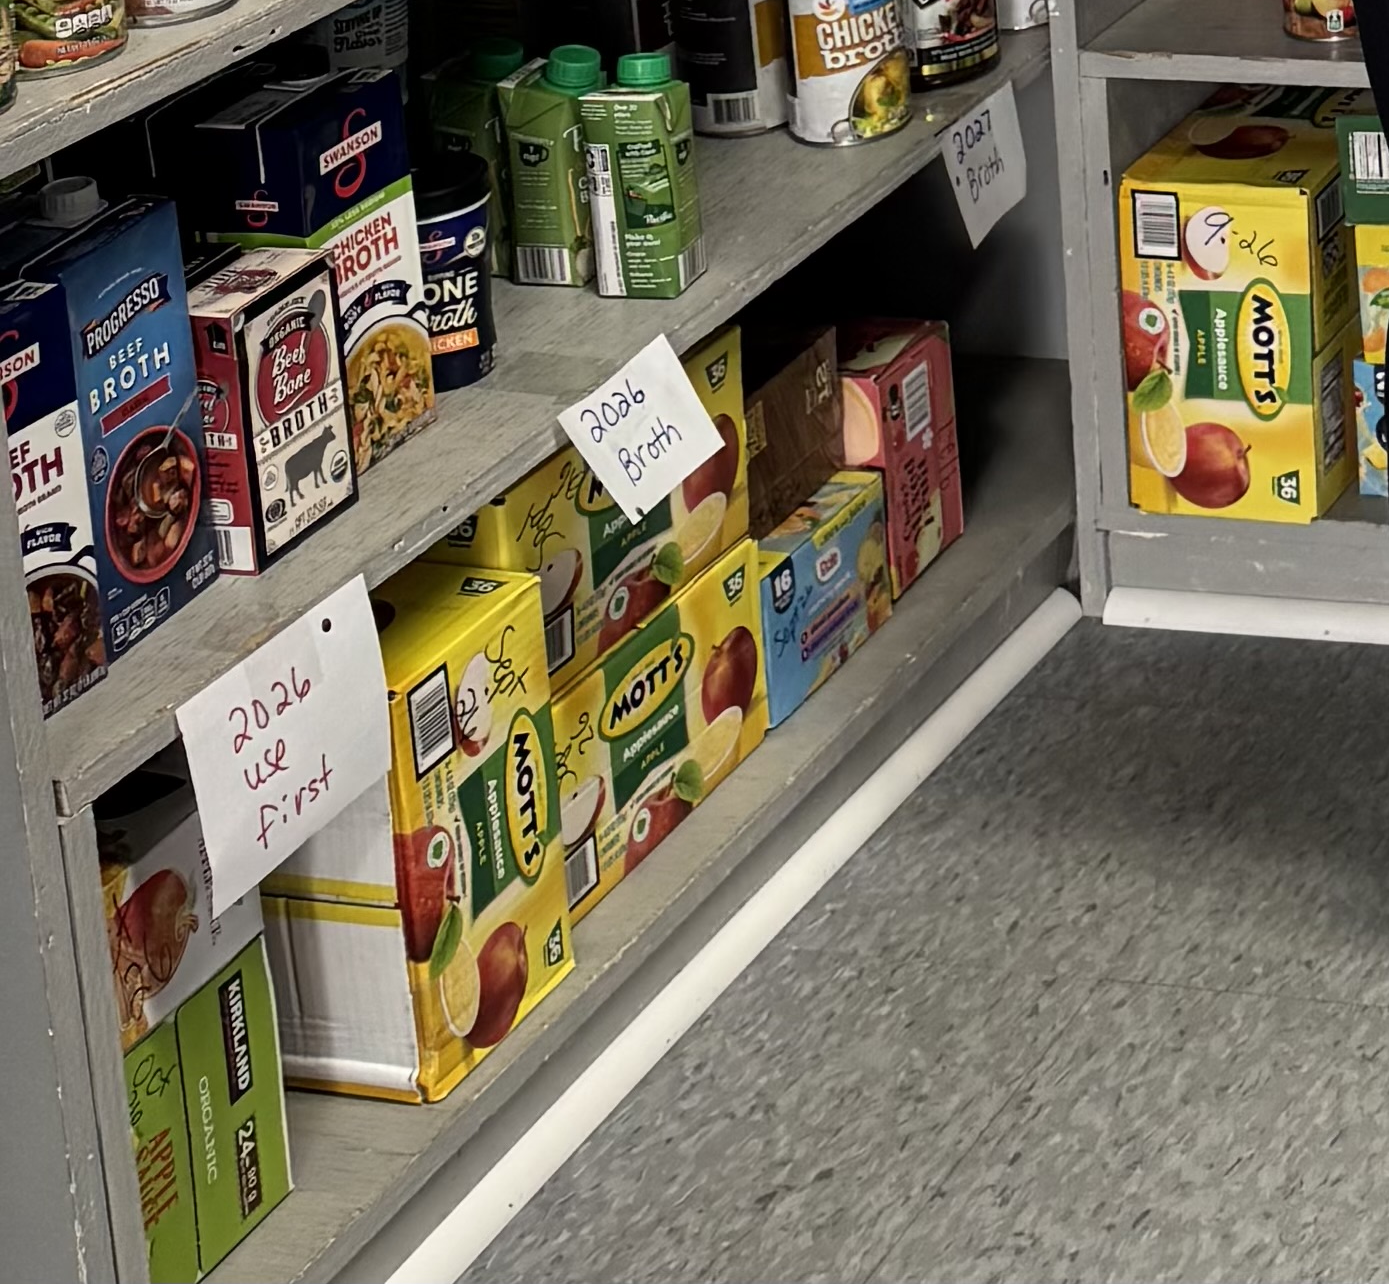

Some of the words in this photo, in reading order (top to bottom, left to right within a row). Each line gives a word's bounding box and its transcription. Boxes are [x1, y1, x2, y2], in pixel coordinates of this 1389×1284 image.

[321, 121, 381, 171] SWANSON
[952, 109, 994, 165] 2027
[84, 277, 161, 357] PROGRESSO
[108, 337, 144, 369] BEEF
[1212, 307, 1229, 392] Applesauce
[1249, 293, 1277, 411] MOTT'S
[89, 342, 173, 415] BROTH
[579, 386, 647, 444] 2026
[269, 395, 329, 448] BROTH
[616, 423, 683, 488] Broth
[772, 568, 792, 595] 16
[229, 666, 313, 759] 2026
[608, 640, 686, 731] MOTT'S
[242, 737, 289, 794] use
[622, 702, 681, 764] Applesauce
[482, 778, 508, 880] Applesauce
[512, 731, 543, 868] MOTT'S
[225, 977, 251, 1092] KIRKLAND
[198, 1075, 217, 1185] ORGANIC
